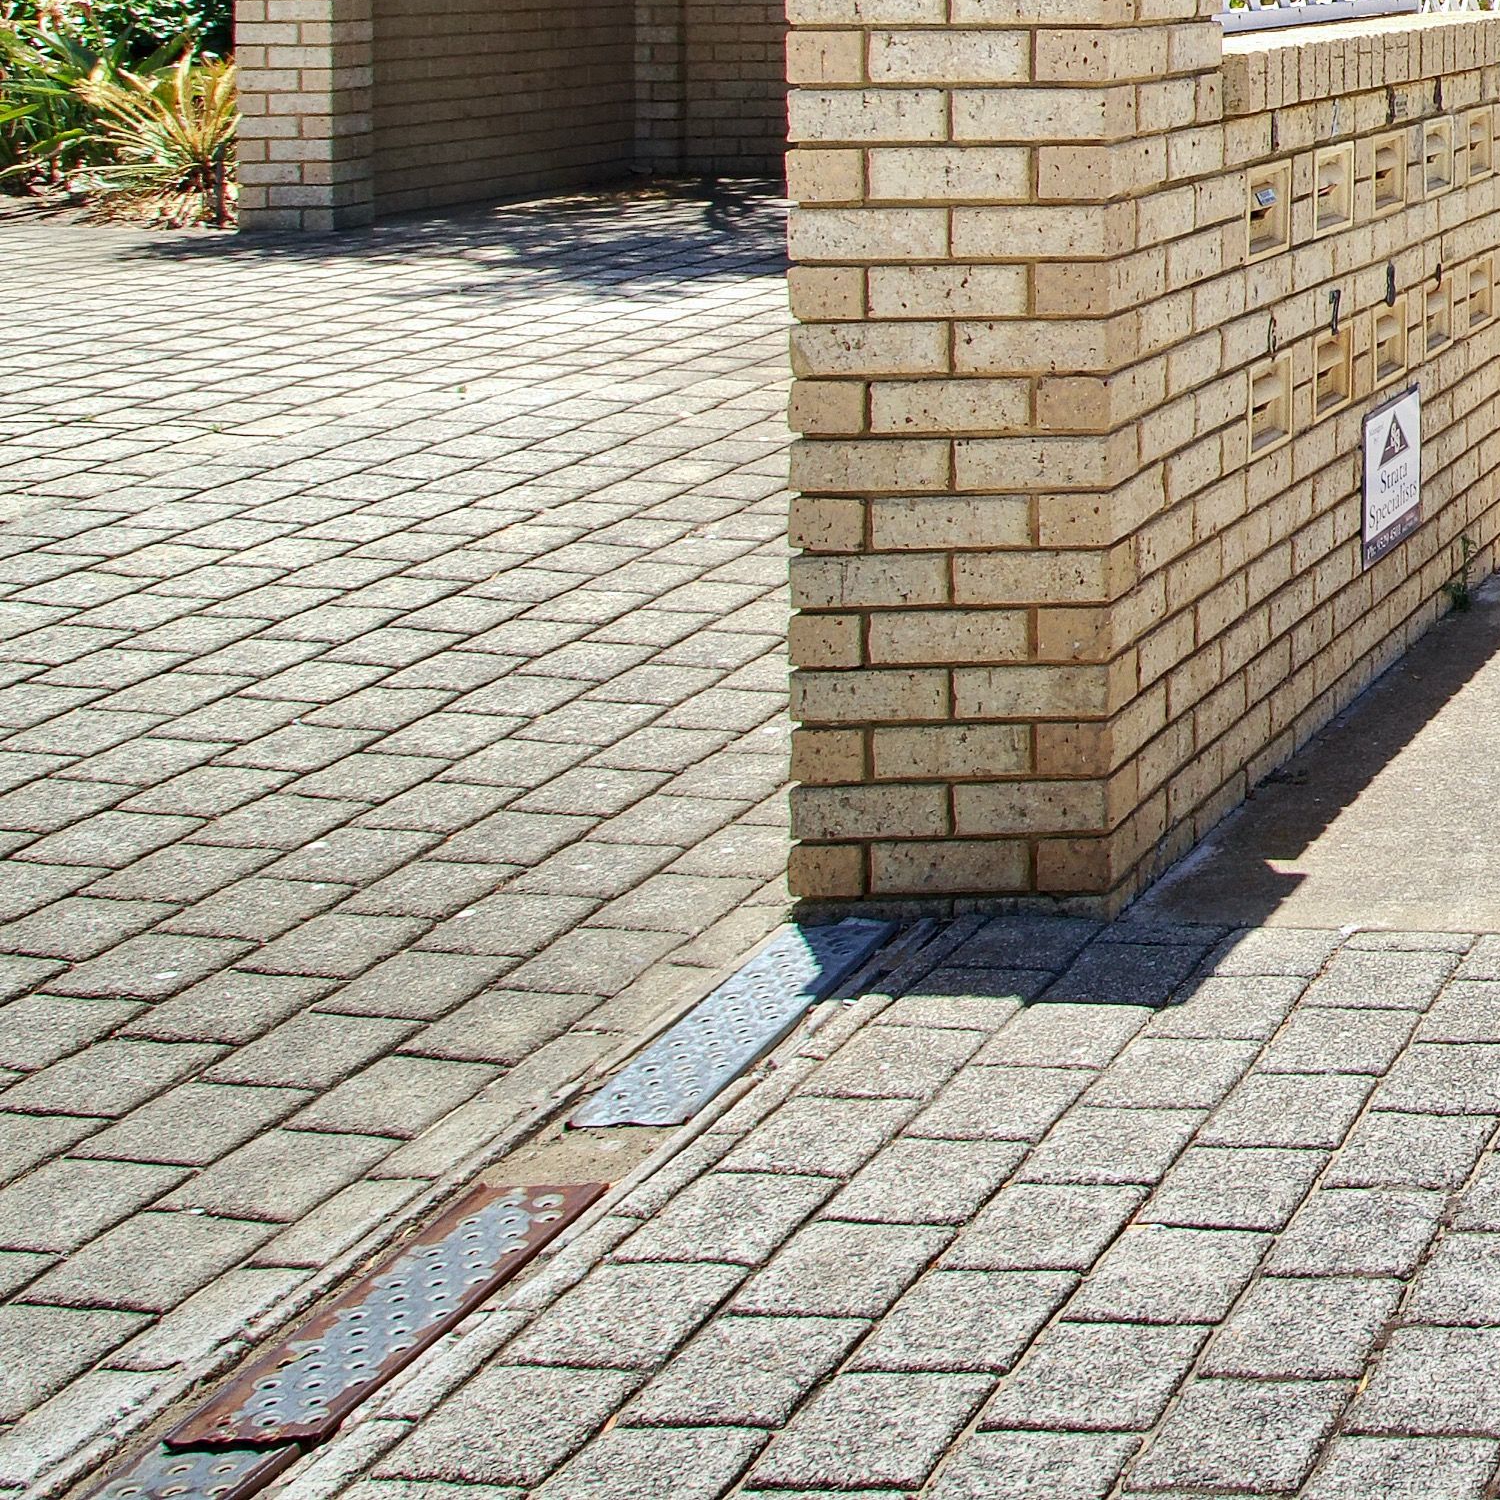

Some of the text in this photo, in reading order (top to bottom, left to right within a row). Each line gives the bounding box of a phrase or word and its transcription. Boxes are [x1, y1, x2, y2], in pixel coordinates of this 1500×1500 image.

[1329, 289, 1341, 336] 7
[1380, 462, 1408, 494] Strata
[1369, 480, 1417, 531] Specialists
